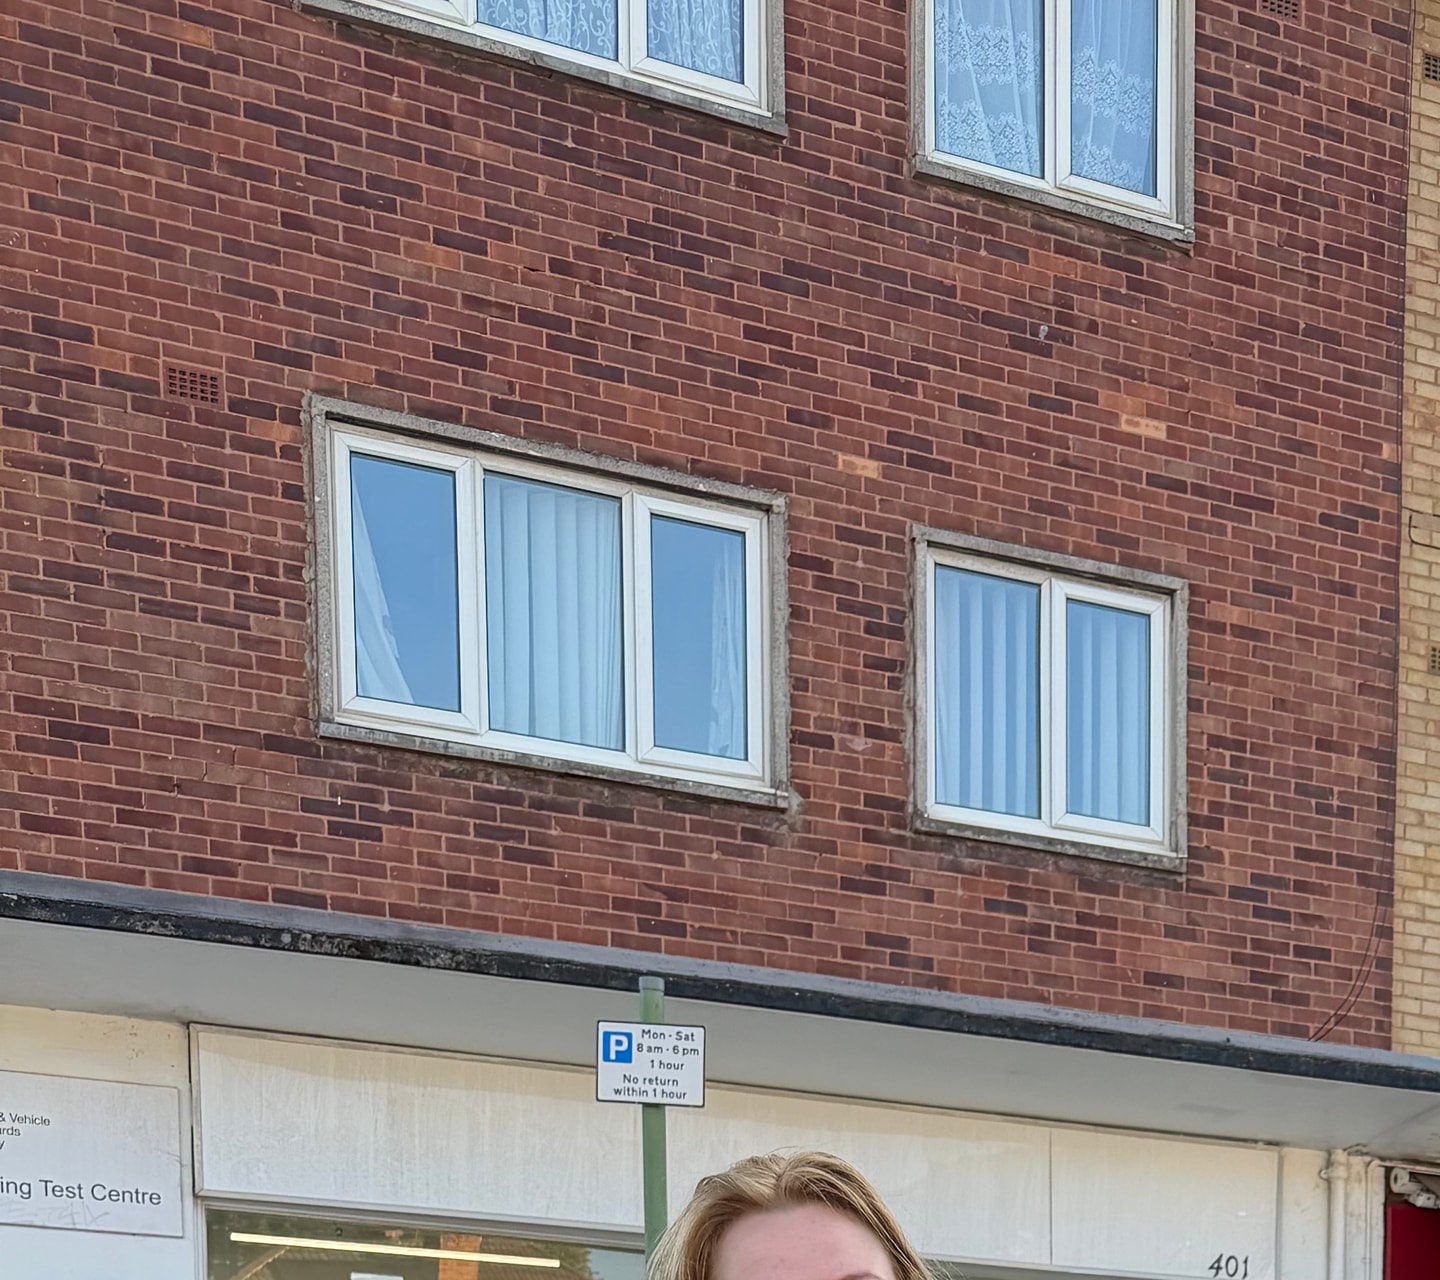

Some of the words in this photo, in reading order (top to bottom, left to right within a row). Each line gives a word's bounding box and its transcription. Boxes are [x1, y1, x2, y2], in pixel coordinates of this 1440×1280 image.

[641, 1029, 666, 1040] Mon
[675, 1031, 695, 1042] Sat
[637, 1043, 644, 1053] 8
[646, 1045, 663, 1054] am
[672, 1045, 680, 1055] 6
[682, 1047, 700, 1057] pm
[659, 1060, 685, 1070] hour
[623, 1074, 639, 1084] No
[643, 1076, 679, 1087] return
[613, 1087, 649, 1098] within
[661, 1089, 687, 1100] hour
[9, 1112, 51, 1127] Vehicle
[39, 1179, 85, 1200] Test
[91, 1183, 162, 1206] Centre
[1208, 1253, 1250, 1280] 401
